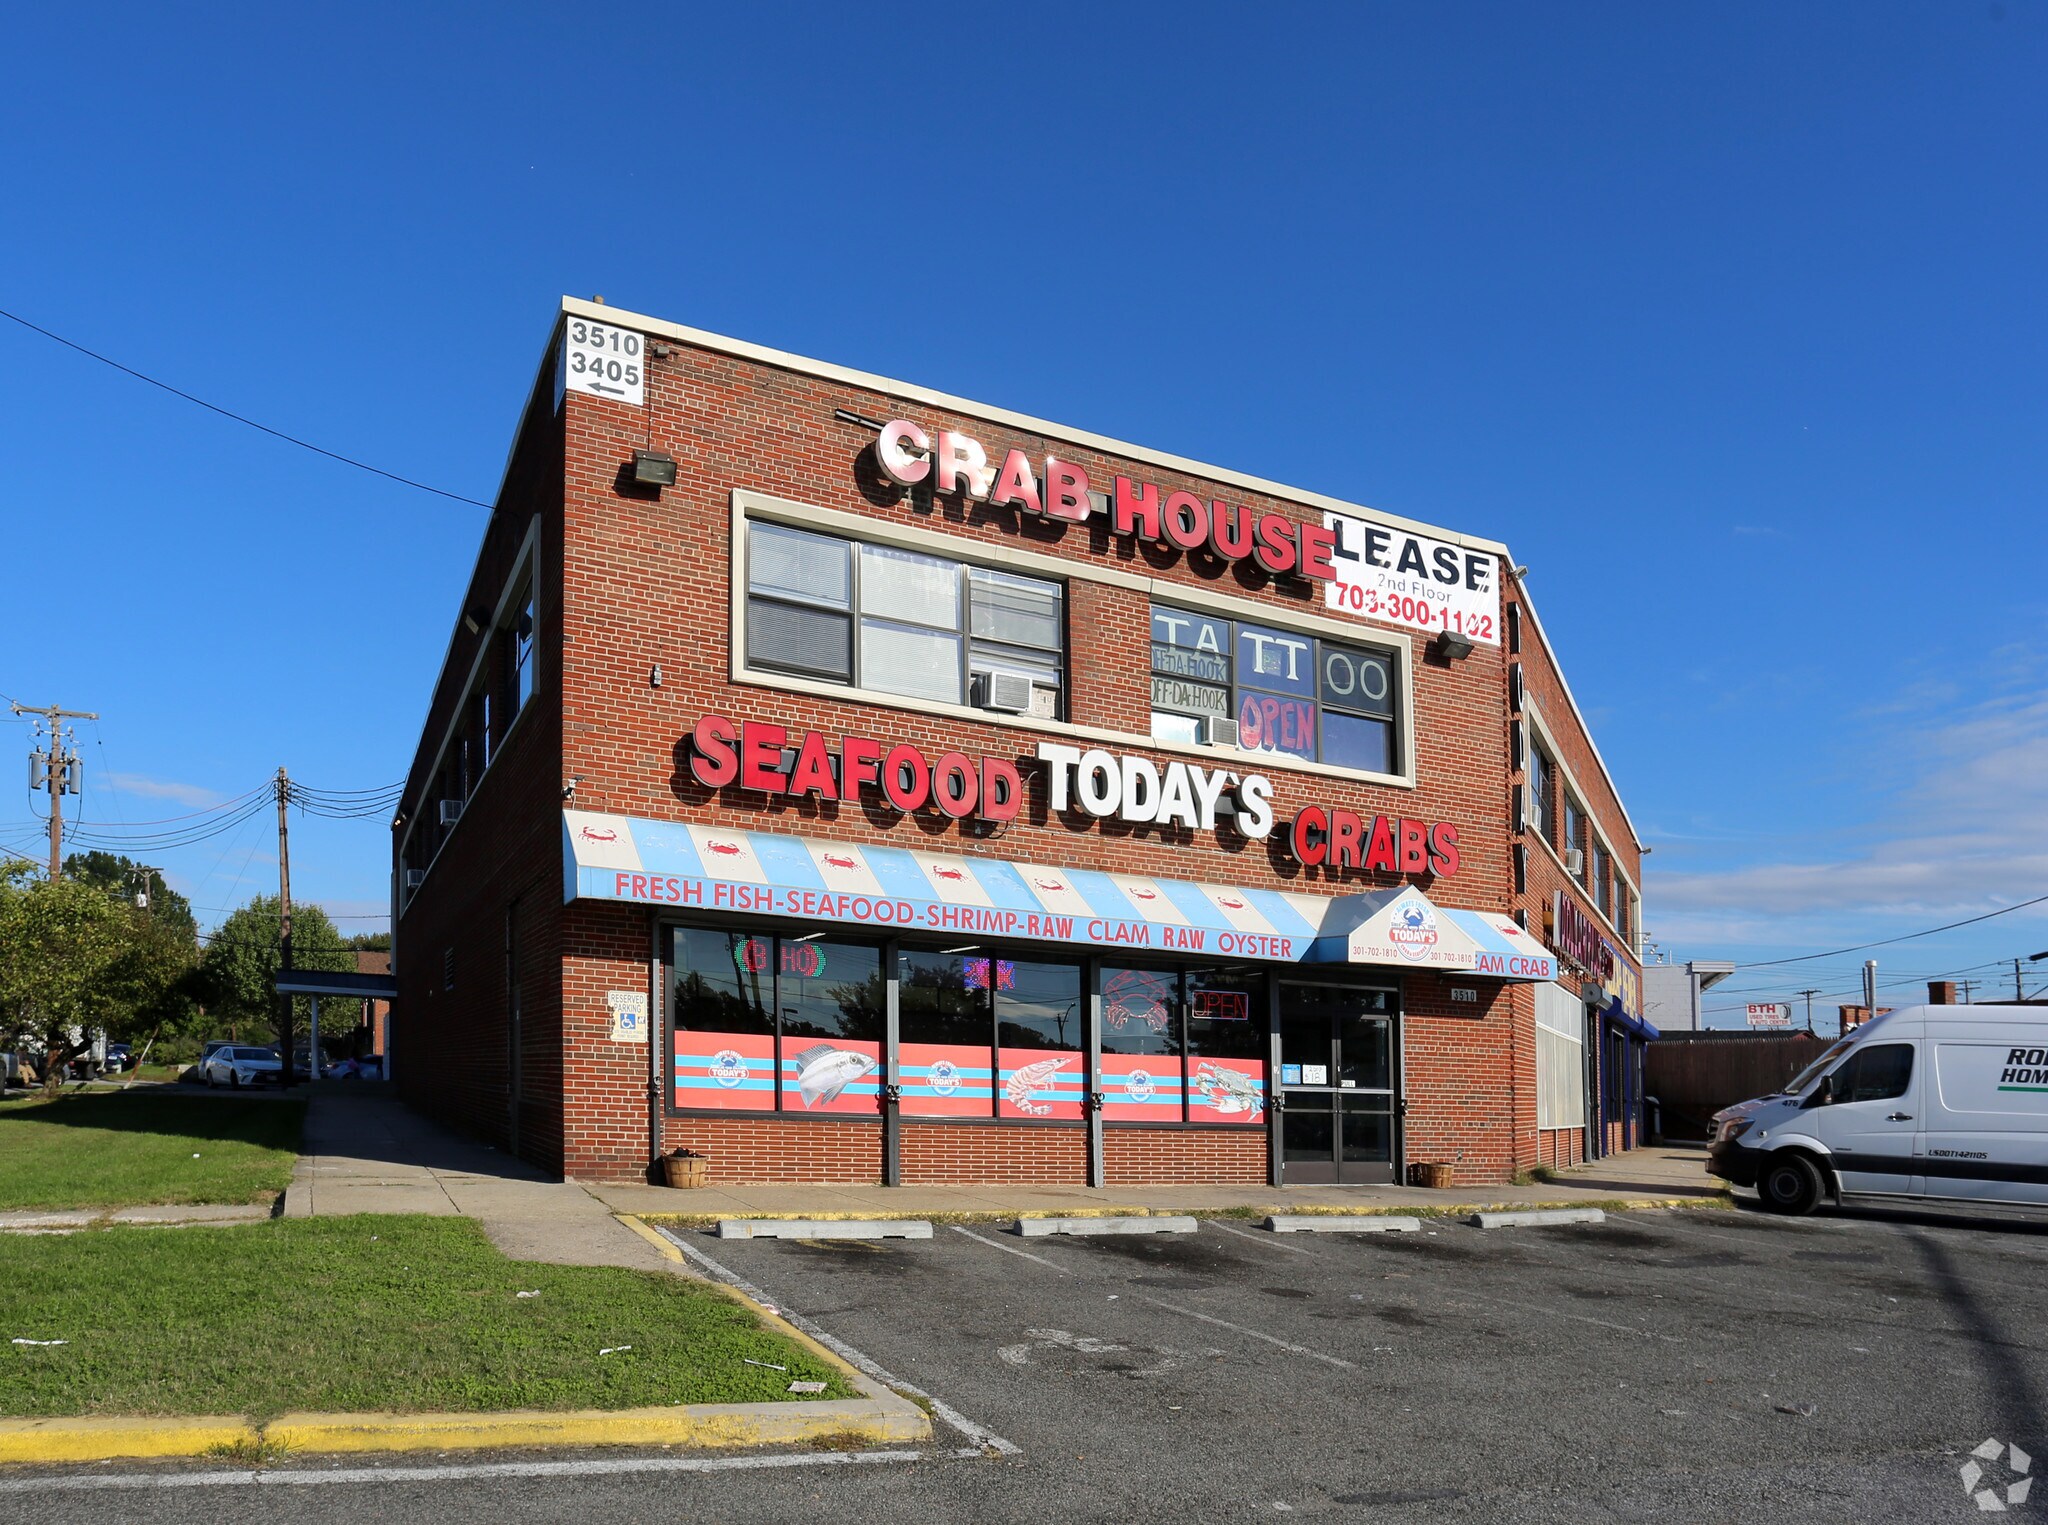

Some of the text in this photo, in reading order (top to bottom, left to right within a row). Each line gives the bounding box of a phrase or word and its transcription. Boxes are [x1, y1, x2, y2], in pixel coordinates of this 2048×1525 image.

[572, 322, 639, 356] 3510
[571, 352, 639, 386] 3405
[876, 419, 1337, 582] CRAB HOUSE
[1333, 518, 1489, 593] LEASE
[1378, 573, 1452, 603] 2nd Floor
[1240, 695, 1315, 750] OPEN
[690, 715, 1022, 821] SEAFOOD
[1037, 742, 1274, 839] TODAY'S
[1290, 805, 1460, 878] CRABS
[615, 873, 703, 904] FRESH
[1087, 920, 1149, 945] CLAM
[1164, 926, 1205, 949] RAW
[1218, 932, 1292, 958] OYSTER
[1392, 929, 1435, 943] TODAY'S
[1353, 946, 1398, 958] 301-702-1810
[1475, 954, 1550, 977] AM CRAB
[611, 993, 644, 1004] RESERVED
[613, 1003, 642, 1013] PARKING
[1194, 992, 1248, 1019] OPEN
[1453, 990, 1475, 1001] 3510
[711, 1068, 747, 1078] TODAY'S
[929, 1078, 960, 1086] TODAY'S
